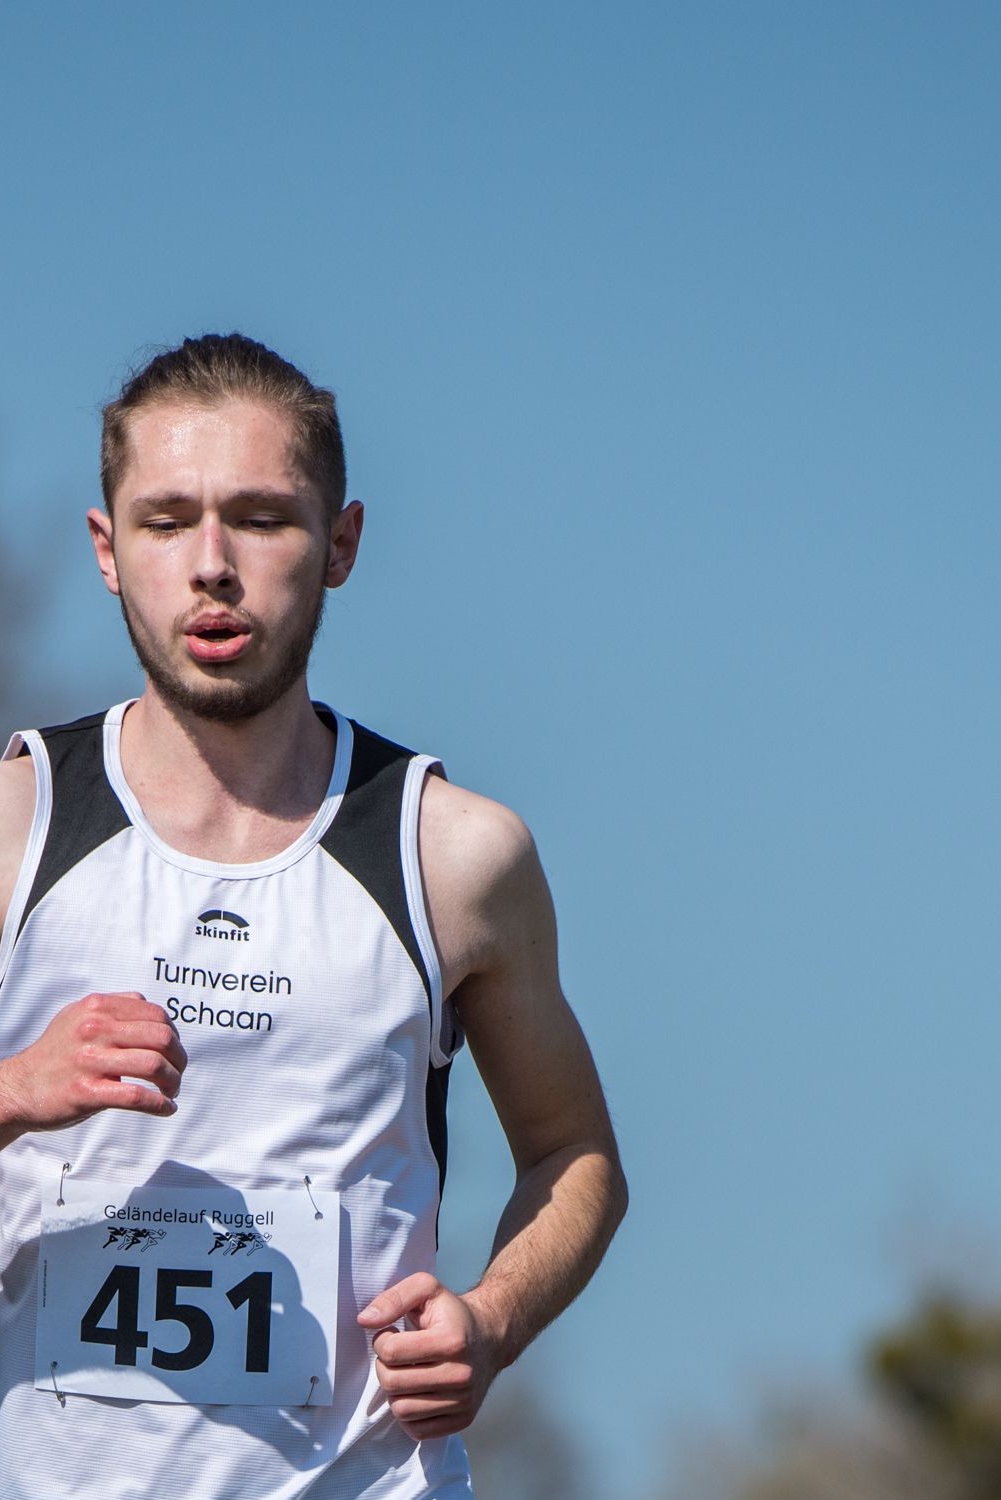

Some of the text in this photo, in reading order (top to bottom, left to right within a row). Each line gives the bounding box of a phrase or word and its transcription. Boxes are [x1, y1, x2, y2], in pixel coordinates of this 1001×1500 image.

[195, 925, 250, 942] skinfit
[153, 957, 292, 995] Turnverein
[166, 997, 272, 1031] Schaan
[104, 1205, 274, 1228] Geländelauf Ruggell
[80, 1264, 273, 1373] 451
